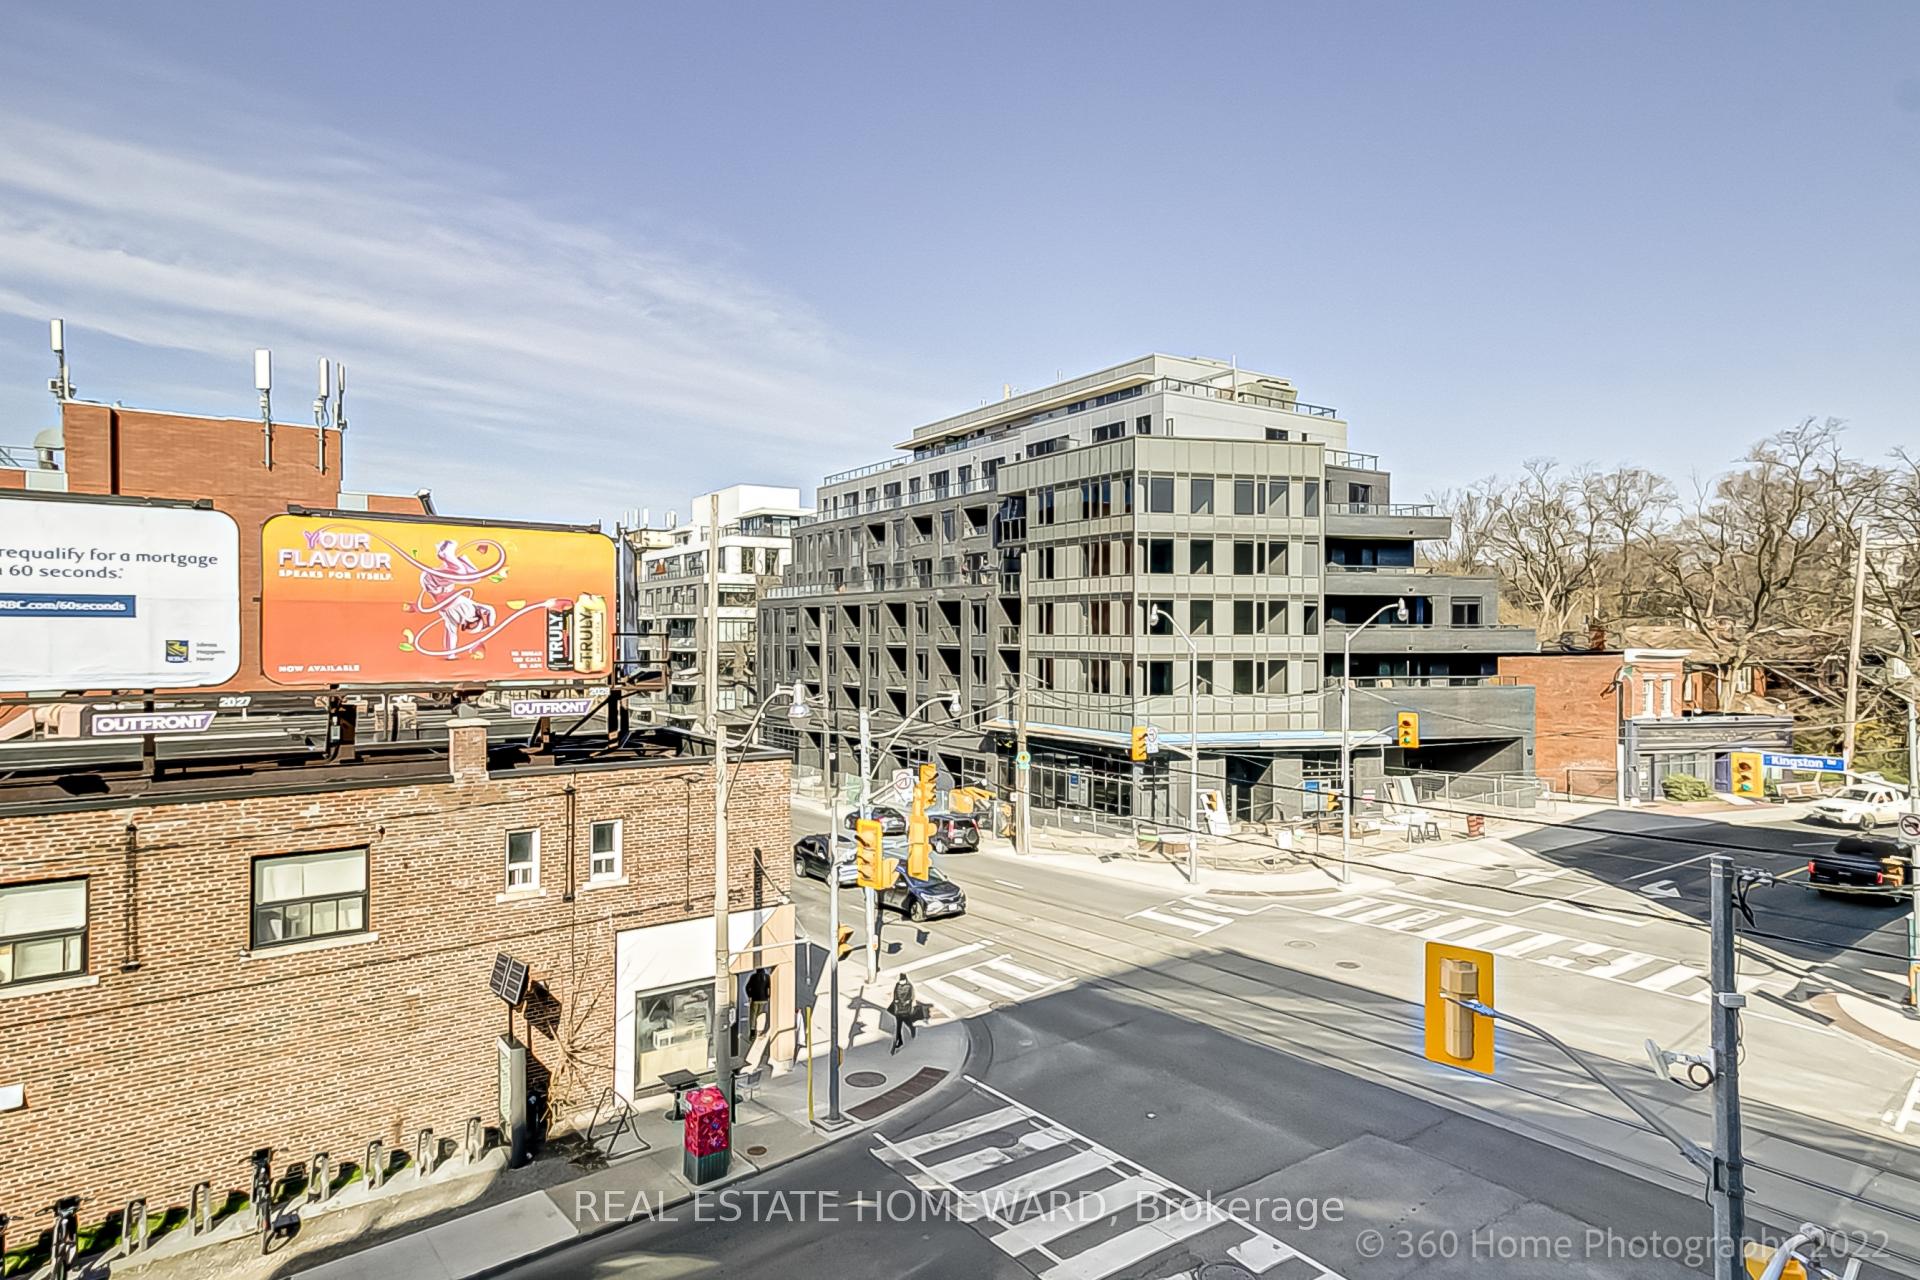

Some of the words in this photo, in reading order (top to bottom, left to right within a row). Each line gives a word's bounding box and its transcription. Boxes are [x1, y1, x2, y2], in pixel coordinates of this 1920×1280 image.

[304, 530, 371, 550] YOUR
[90, 548, 117, 561] for
[120, 552, 131, 562] a
[136, 553, 218, 568] mortgage
[279, 549, 392, 570] FLAVOUR
[9, 565, 33, 577] 60
[279, 569, 323, 578] SPEAKS
[329, 571, 352, 580] FOR
[549, 611, 564, 661] TRULY
[580, 611, 593, 662] TRULY
[278, 665, 304, 673] NOW
[307, 664, 360, 673] AVAILABLE
[218, 696, 252, 708] 2027
[514, 701, 588, 715] OUTFRONT
[97, 714, 207, 732] OUTFRONT
[1771, 755, 1824, 769] Kingston
